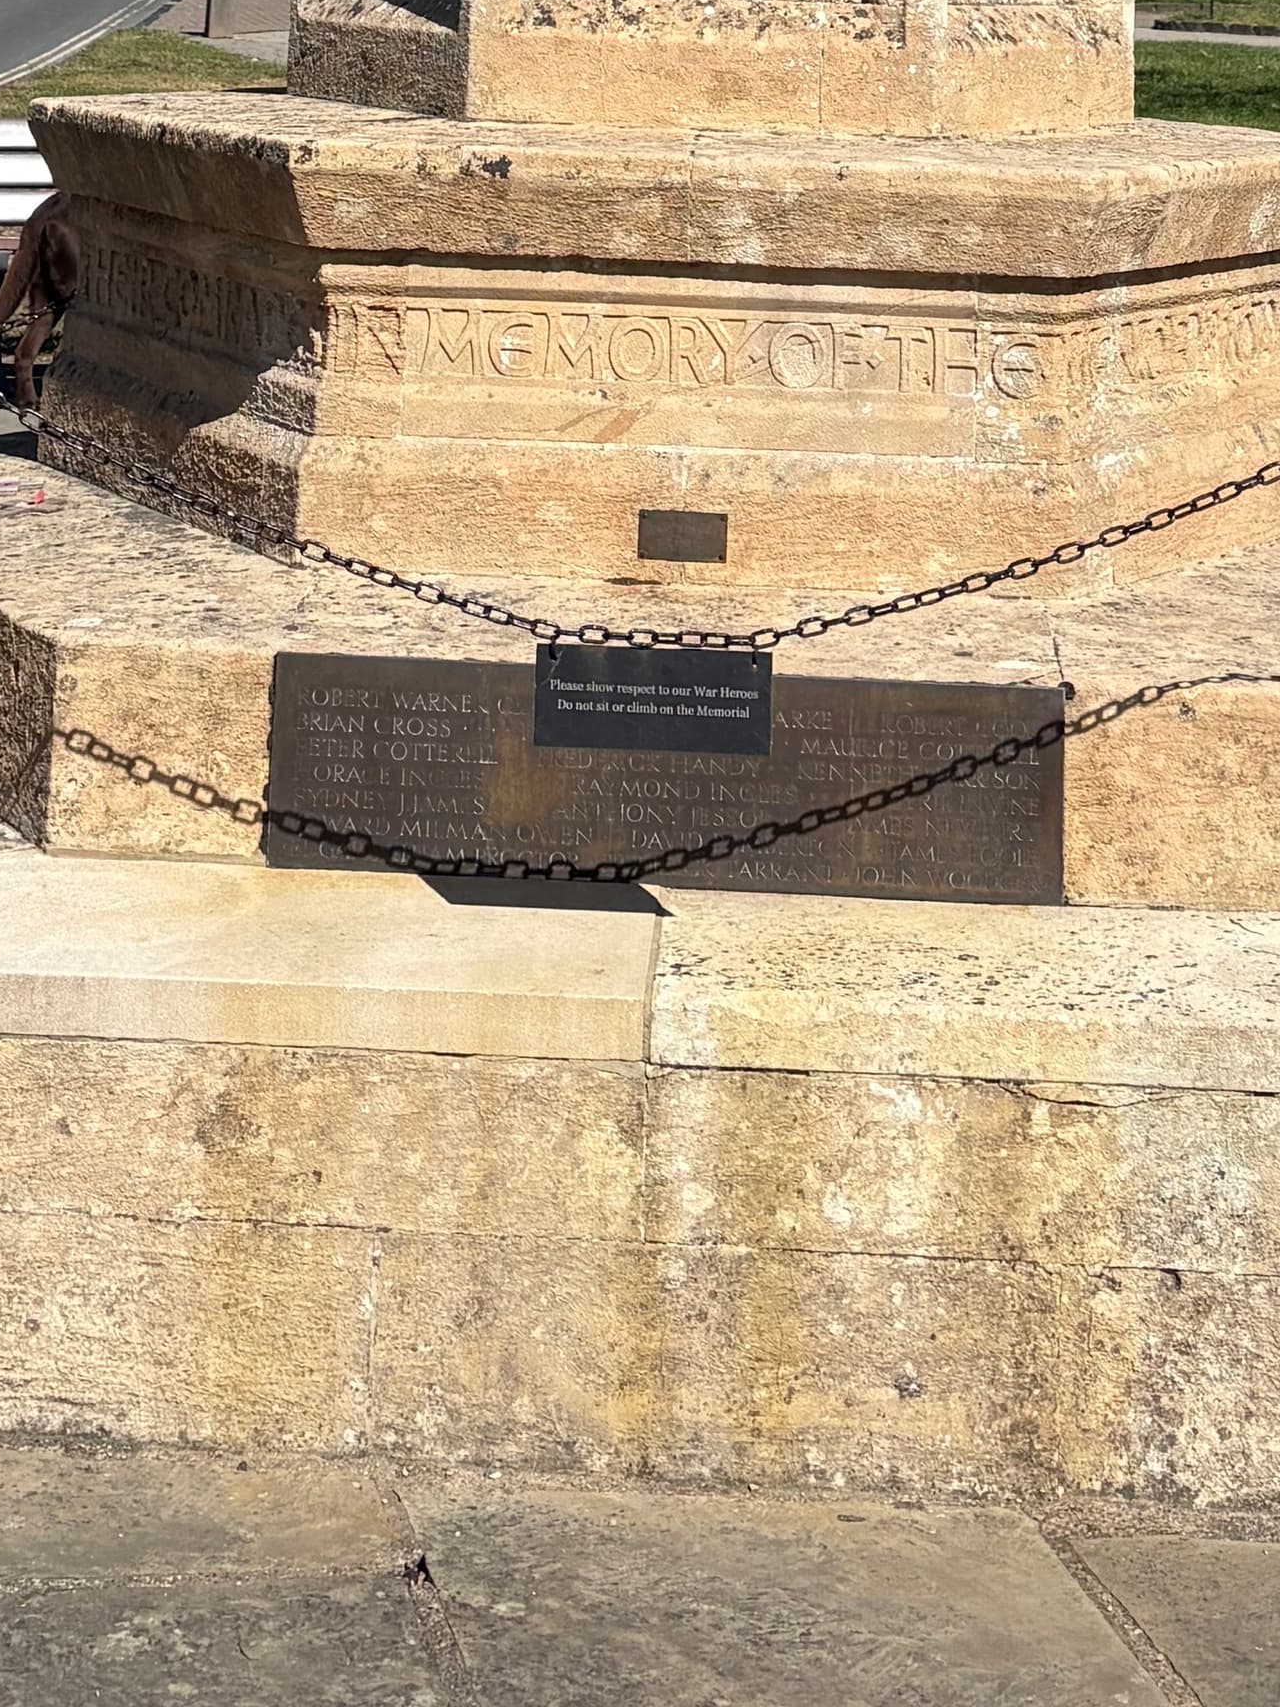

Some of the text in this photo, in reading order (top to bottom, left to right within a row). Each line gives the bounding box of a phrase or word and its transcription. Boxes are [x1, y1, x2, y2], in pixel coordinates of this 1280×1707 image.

[417, 306, 752, 387] MEMORY
[768, 319, 865, 391] OF
[882, 323, 1046, 400] THE
[549, 678, 760, 700] Please show respect to our War Heroes
[557, 698, 750, 719] Do not sit or climb on the Memorial
[297, 713, 365, 734] BRIAN
[373, 716, 452, 738] CROSS
[669, 754, 761, 778] HANDY
